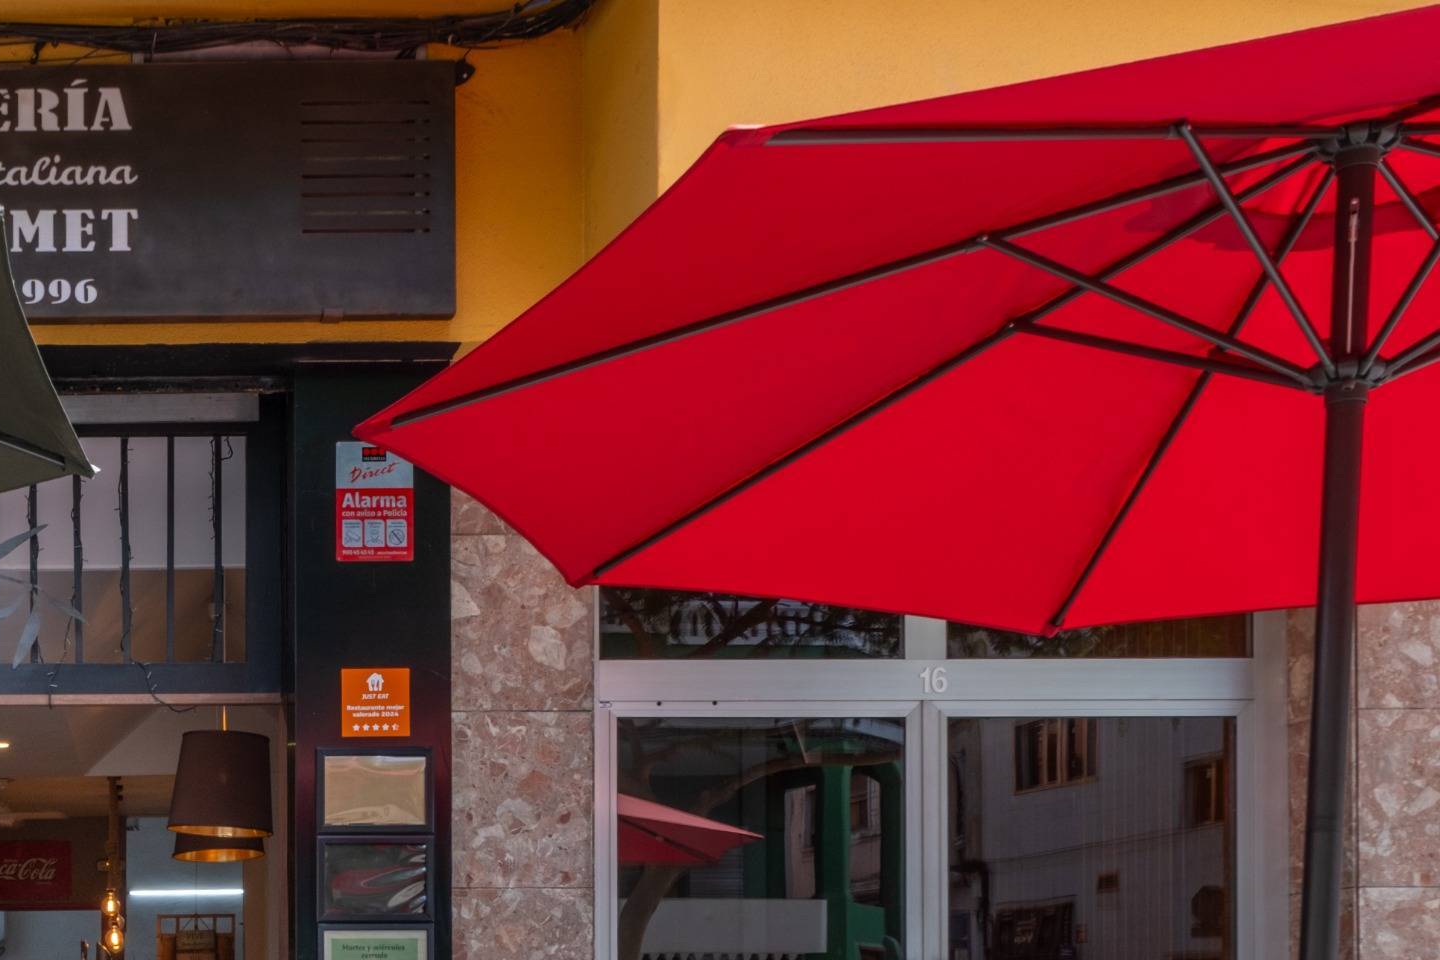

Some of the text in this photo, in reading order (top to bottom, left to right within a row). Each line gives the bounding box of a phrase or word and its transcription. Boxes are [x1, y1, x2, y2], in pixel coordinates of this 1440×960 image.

[10, 209, 139, 252] MET
[22, 279, 98, 304] 996
[350, 462, 401, 483] Direct
[342, 492, 407, 508] Alarma
[920, 666, 948, 693] 16
